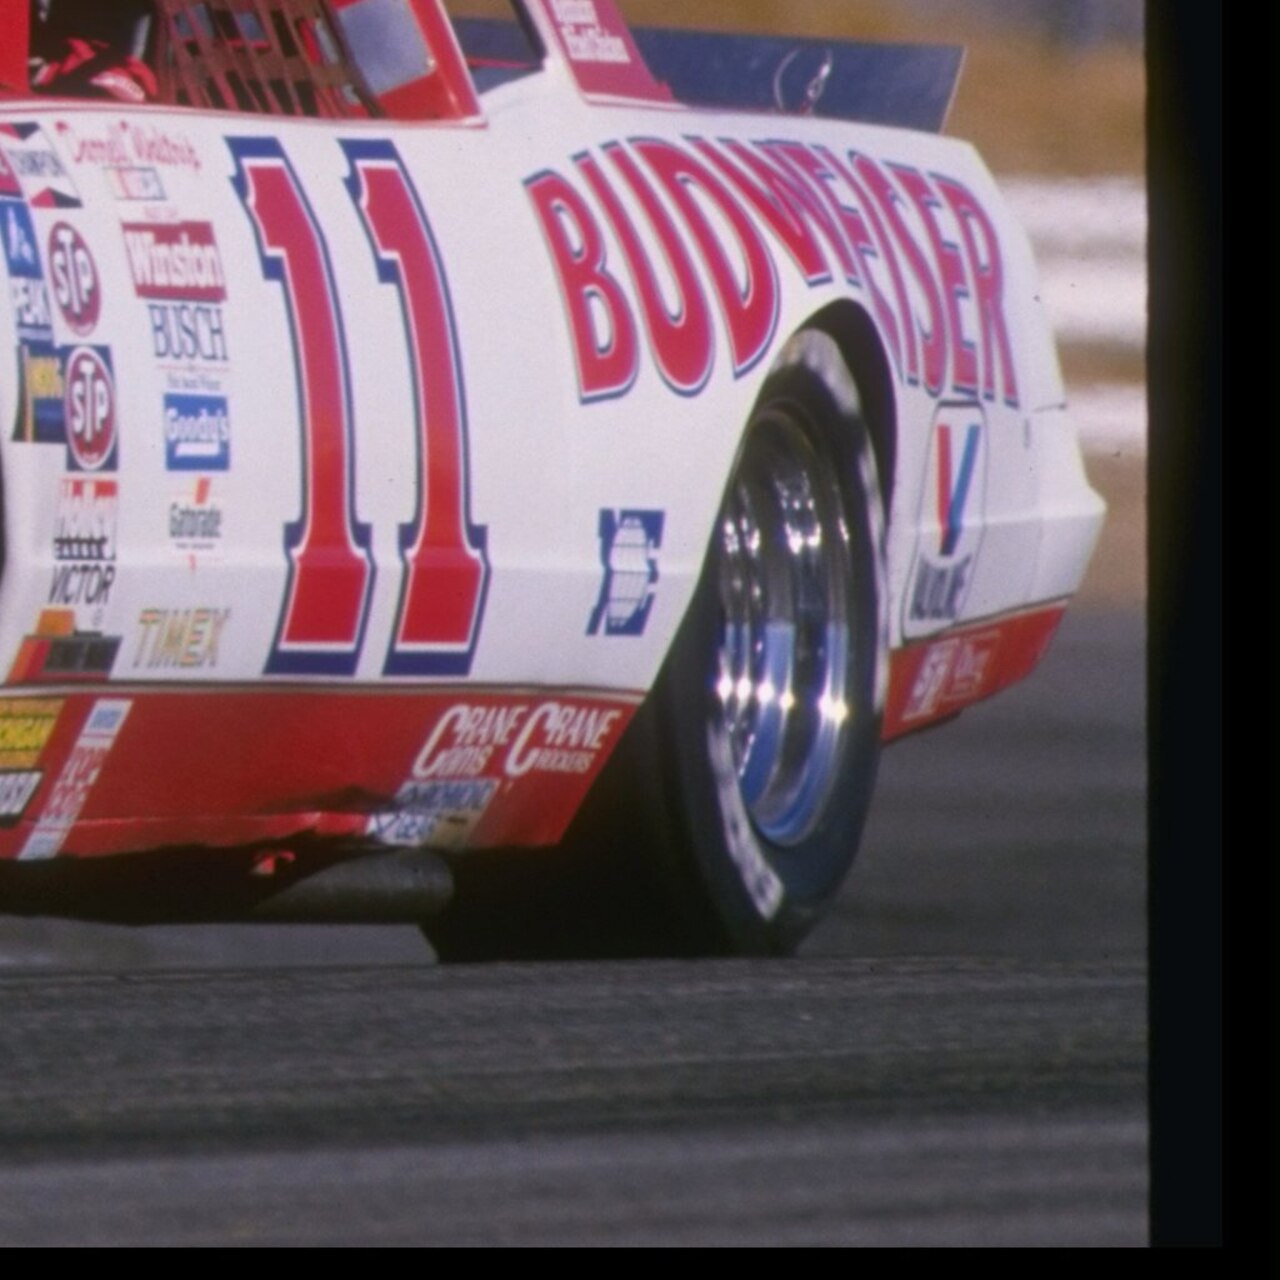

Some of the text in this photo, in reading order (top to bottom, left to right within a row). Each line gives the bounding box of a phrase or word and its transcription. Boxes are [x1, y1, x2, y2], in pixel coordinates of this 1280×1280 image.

[51, 228, 95, 315] STP
[521, 133, 1020, 407] BUDWEISER
[149, 304, 230, 362] BUSCH
[73, 360, 109, 442] STP
[225, 137, 492, 677] 11
[47, 566, 116, 604] VICTOR
[132, 608, 232, 668] TIMEX
